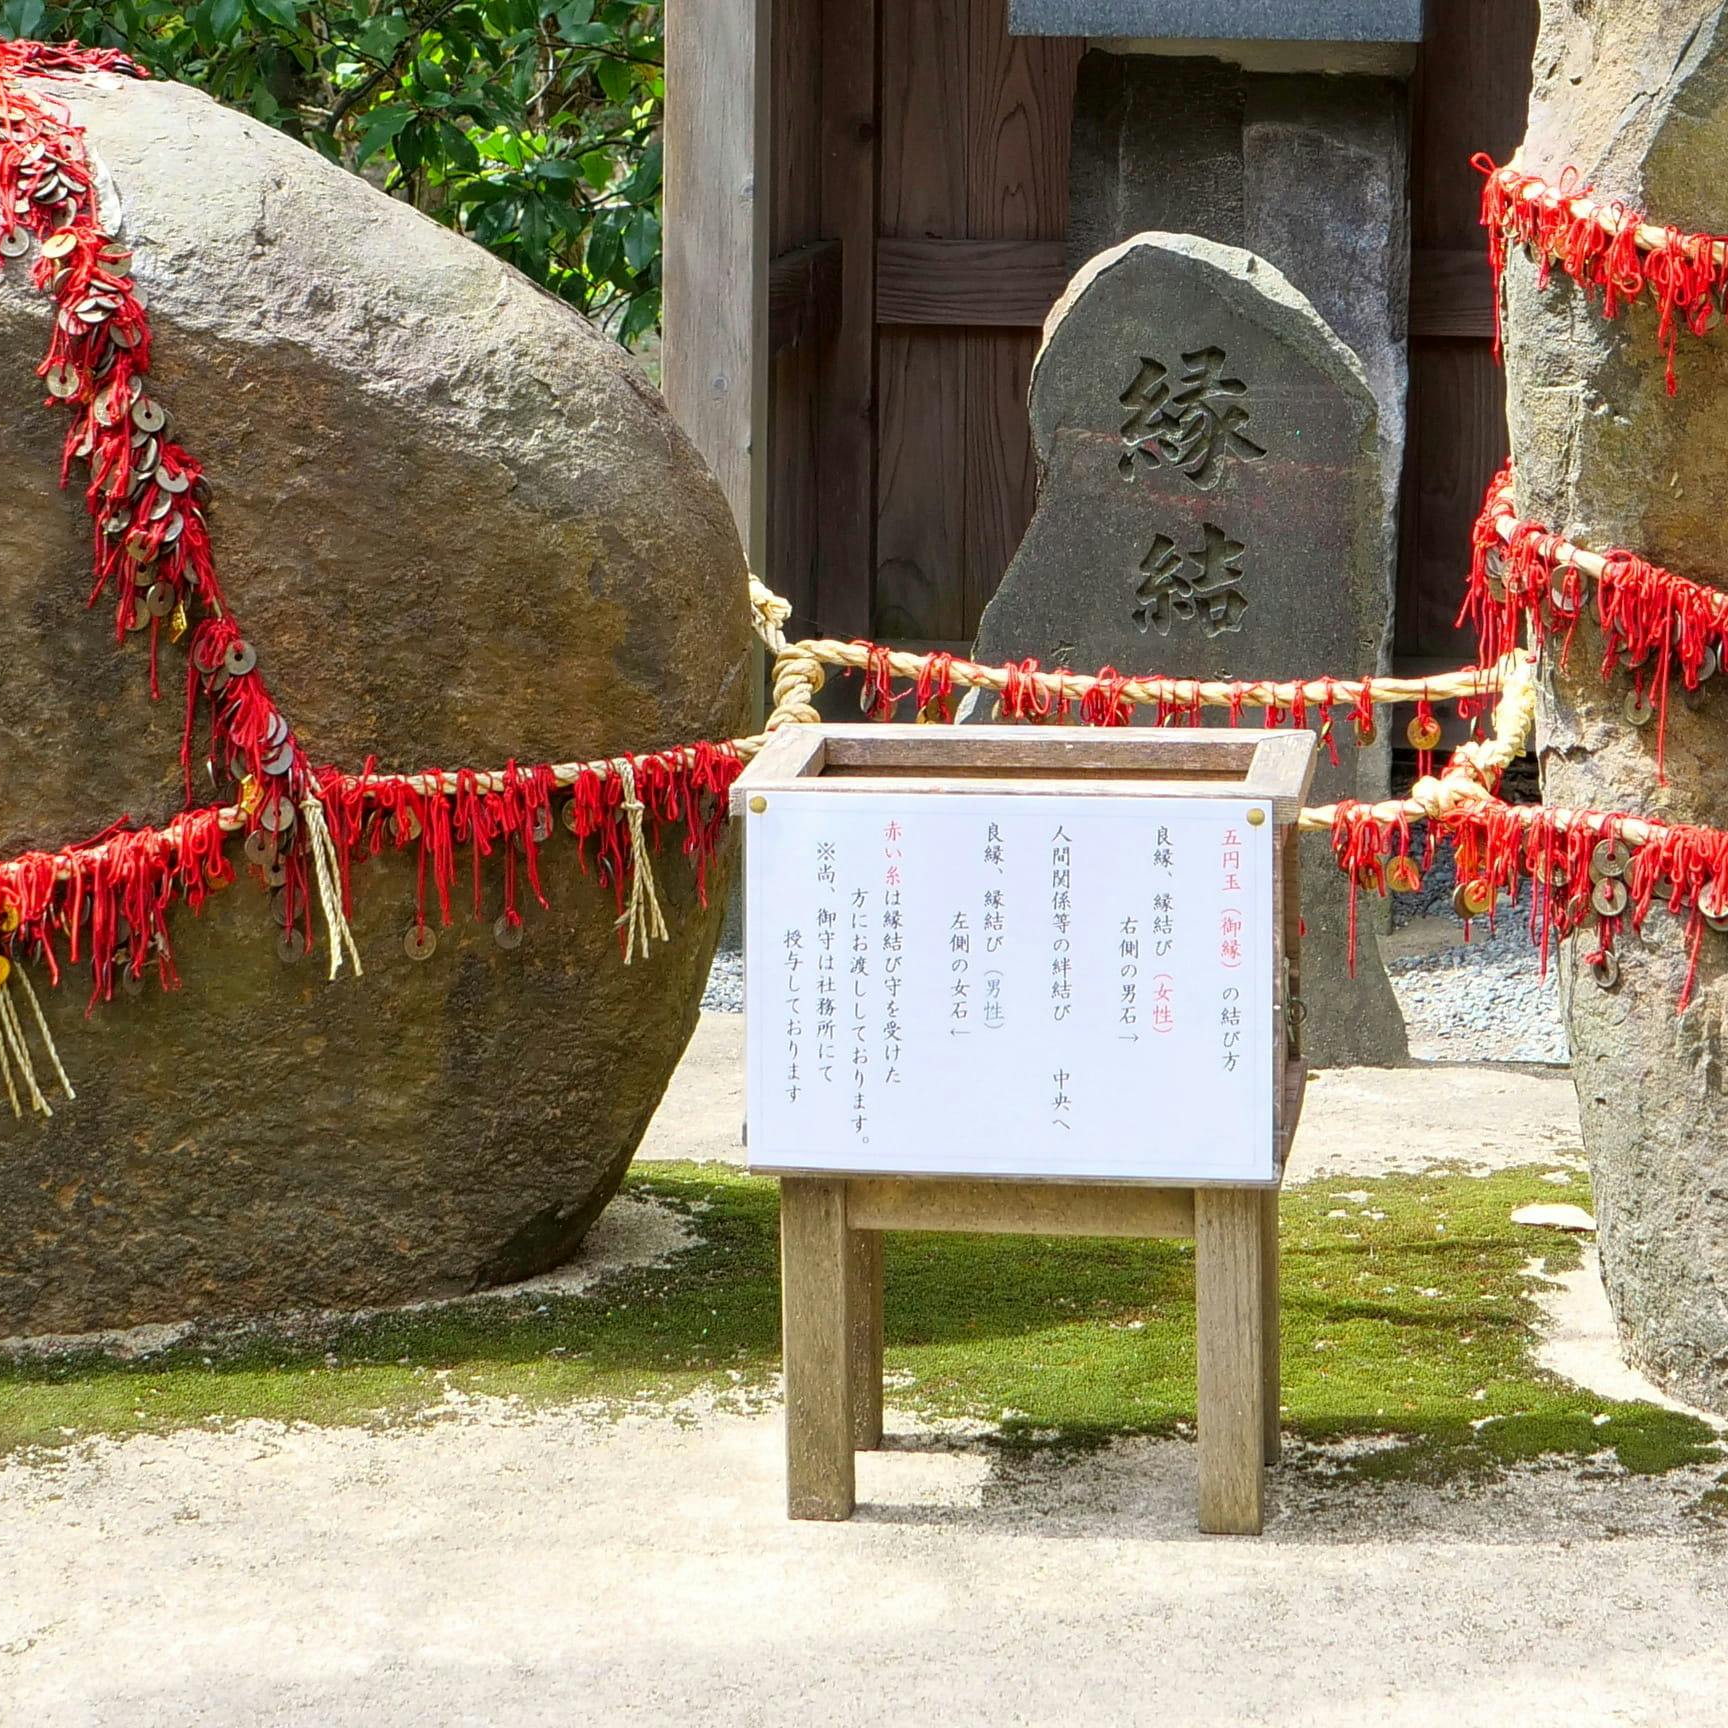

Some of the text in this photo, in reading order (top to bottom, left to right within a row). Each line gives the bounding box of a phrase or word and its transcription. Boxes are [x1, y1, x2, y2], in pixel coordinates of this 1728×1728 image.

[783, 928, 803, 1103] 授与しております
[849, 887, 870, 1144] 方にお渡ししております。
[882, 820, 903, 1083] 赤い糸は縁結び守を受けた
[949, 911, 970, 1019] 左側の女石
[1051, 825, 1073, 1130] 人間関係等の絆結び 中央へ
[1119, 916, 1139, 1024] 右側の男石
